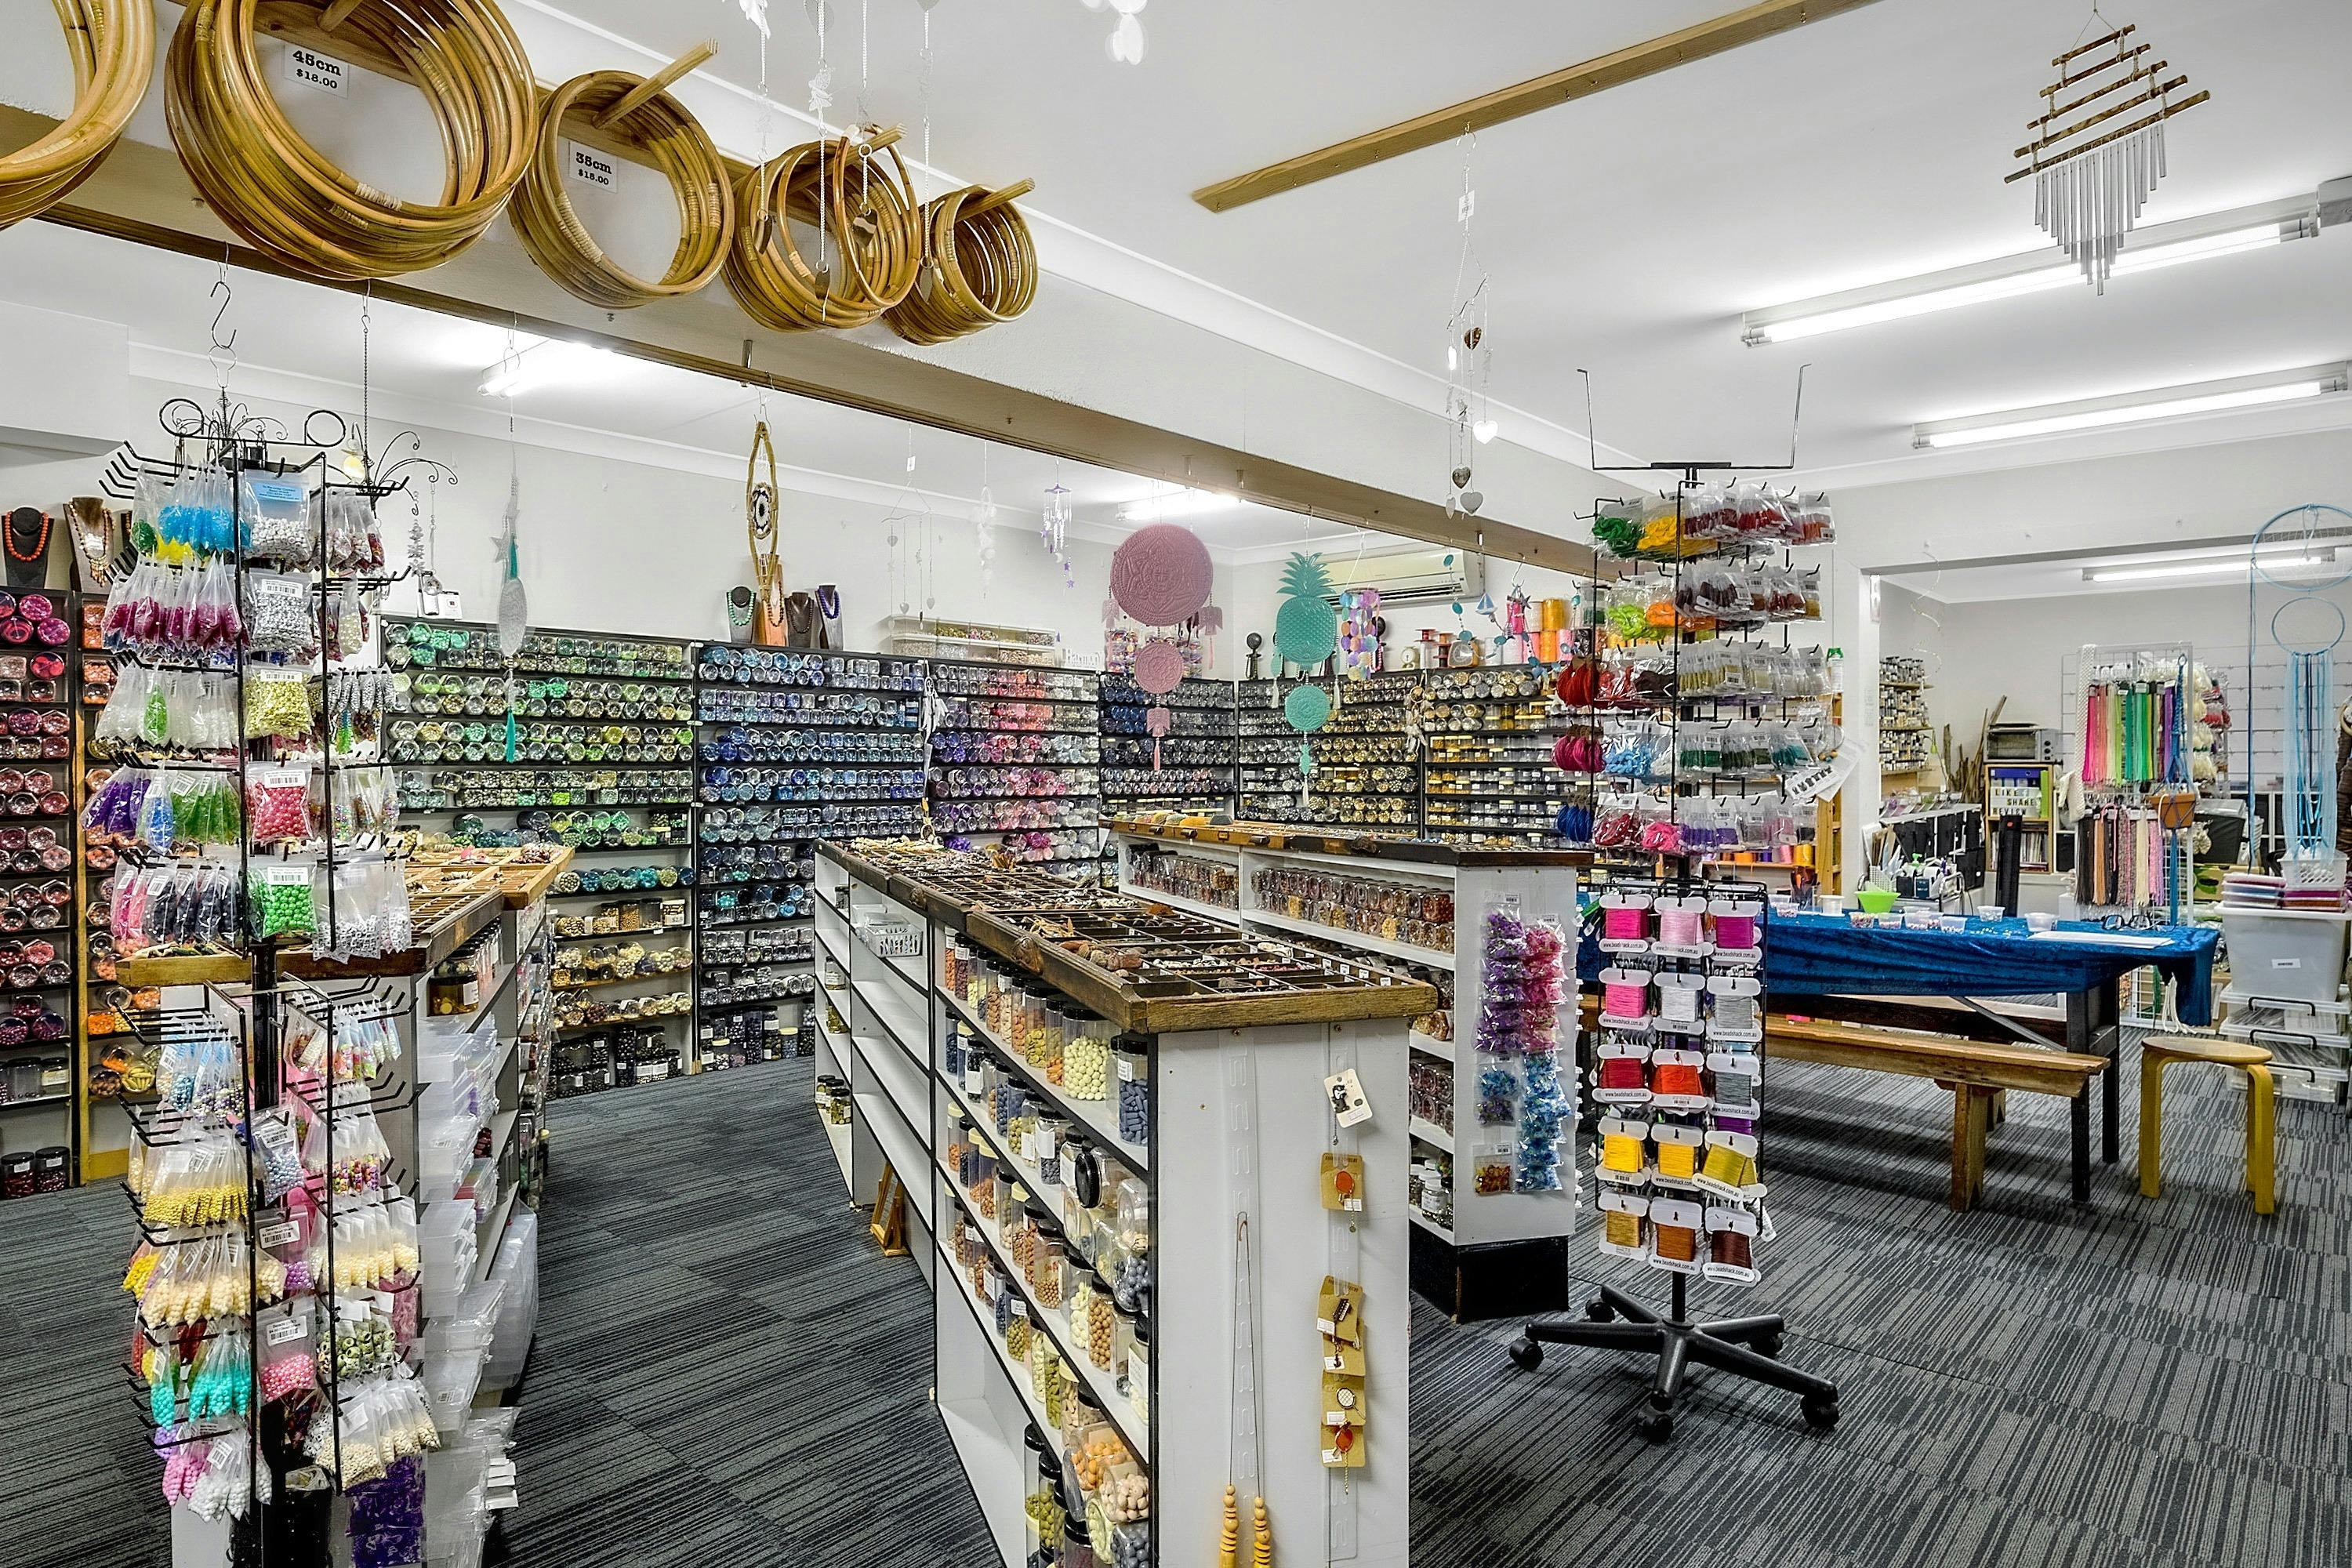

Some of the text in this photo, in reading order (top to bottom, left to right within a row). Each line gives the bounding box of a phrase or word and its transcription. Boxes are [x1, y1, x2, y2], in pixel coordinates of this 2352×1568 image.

[296, 68, 338, 89] $18.00
[1995, 788, 2018, 797] LIKE
[2007, 798, 2034, 807] SHARE
